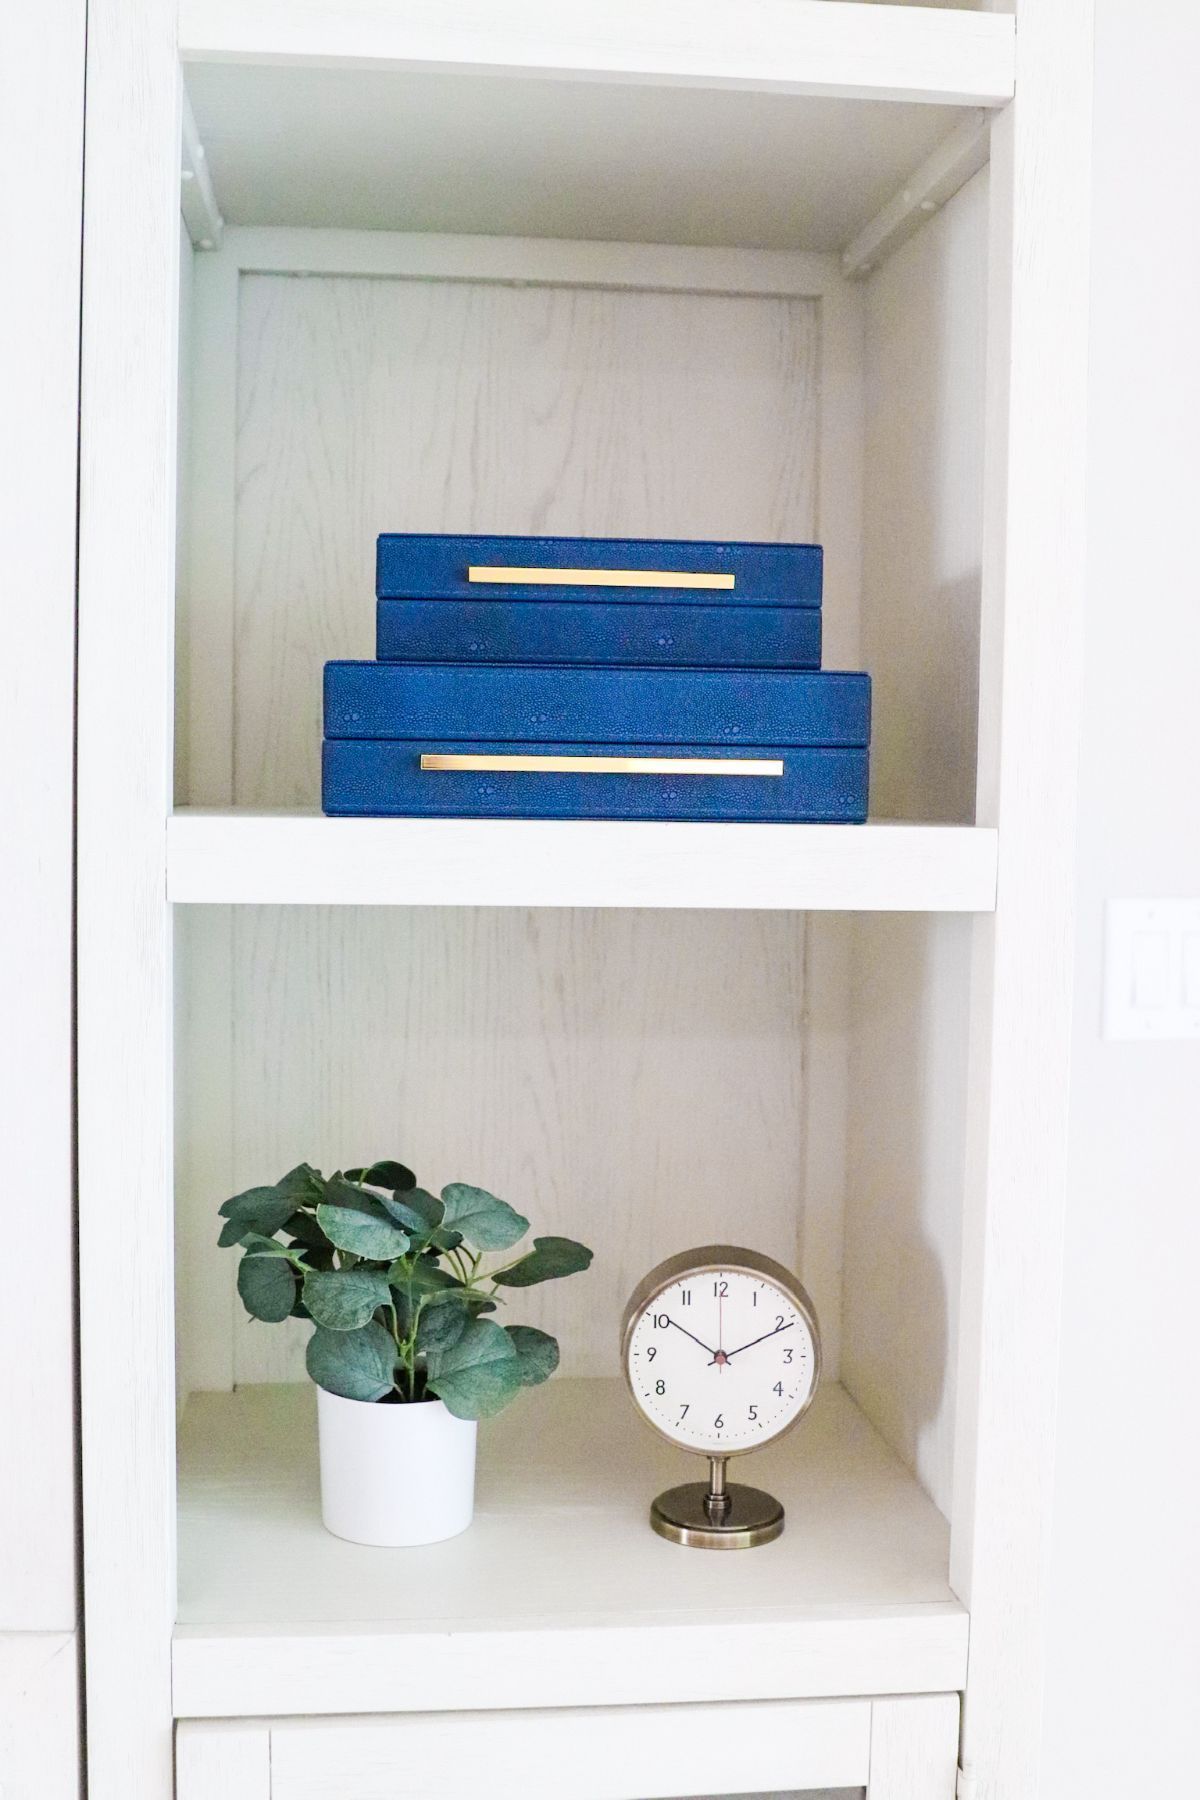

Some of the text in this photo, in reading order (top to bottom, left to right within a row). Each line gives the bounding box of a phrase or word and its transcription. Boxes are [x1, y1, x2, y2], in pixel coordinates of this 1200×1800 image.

[682, 1290, 691, 1306] 11
[713, 1282, 729, 1298] 12
[653, 1314, 670, 1329] 10
[775, 1315, 786, 1332] 2
[647, 1347, 657, 1363] 9
[783, 1349, 793, 1364] 3
[655, 1379, 666, 1396] 8
[772, 1381, 784, 1397] 4
[680, 1404, 690, 1420] 7
[748, 1405, 758, 1421] 5
[714, 1413, 724, 1429] 6
